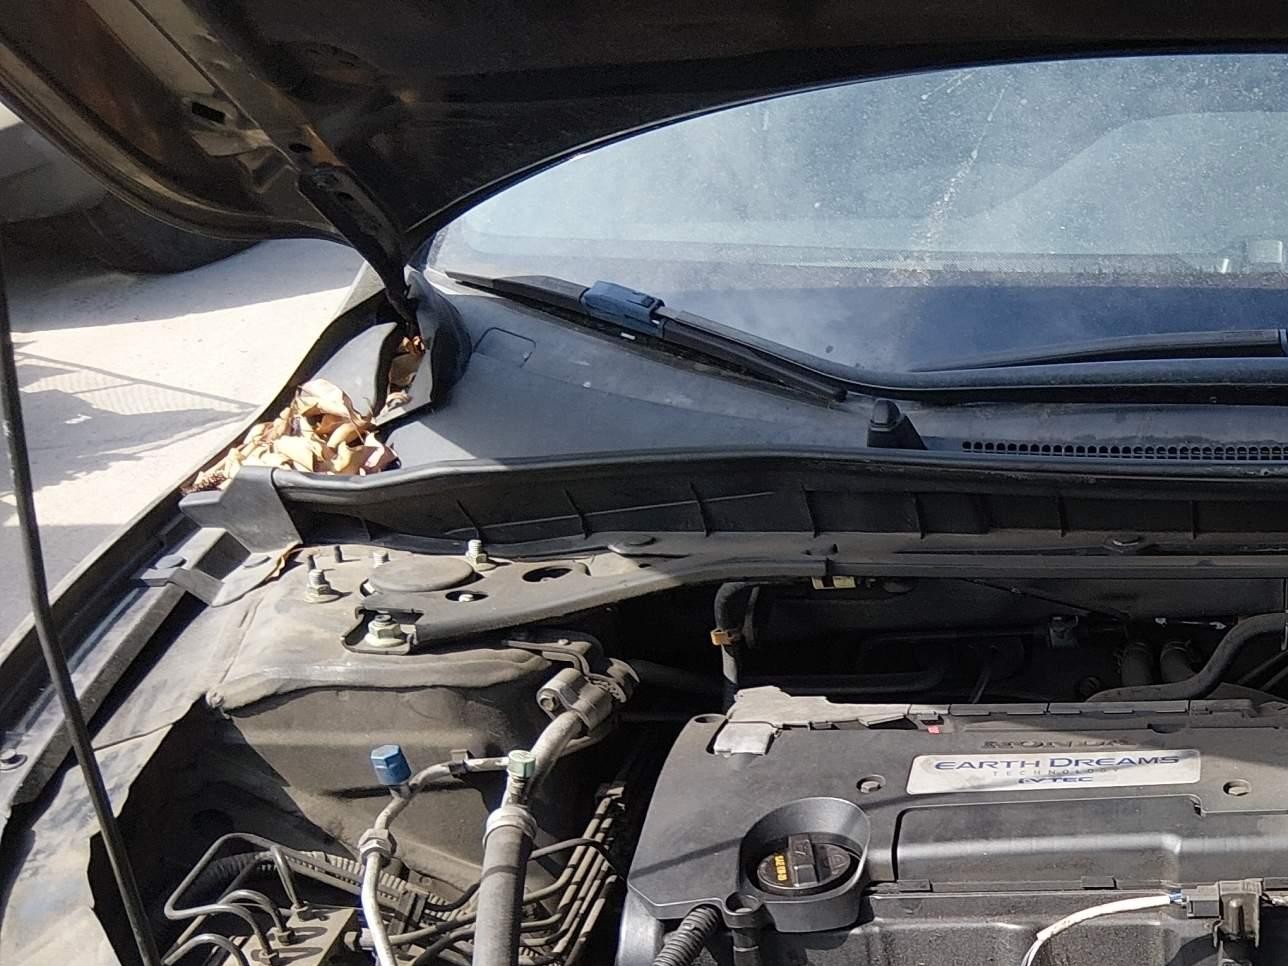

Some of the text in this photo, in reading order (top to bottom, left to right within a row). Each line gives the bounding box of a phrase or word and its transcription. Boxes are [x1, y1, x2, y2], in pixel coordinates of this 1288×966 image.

[934, 755, 1180, 771] EARTH DREAMS
[992, 767, 1120, 776] TECHNOLOGY
